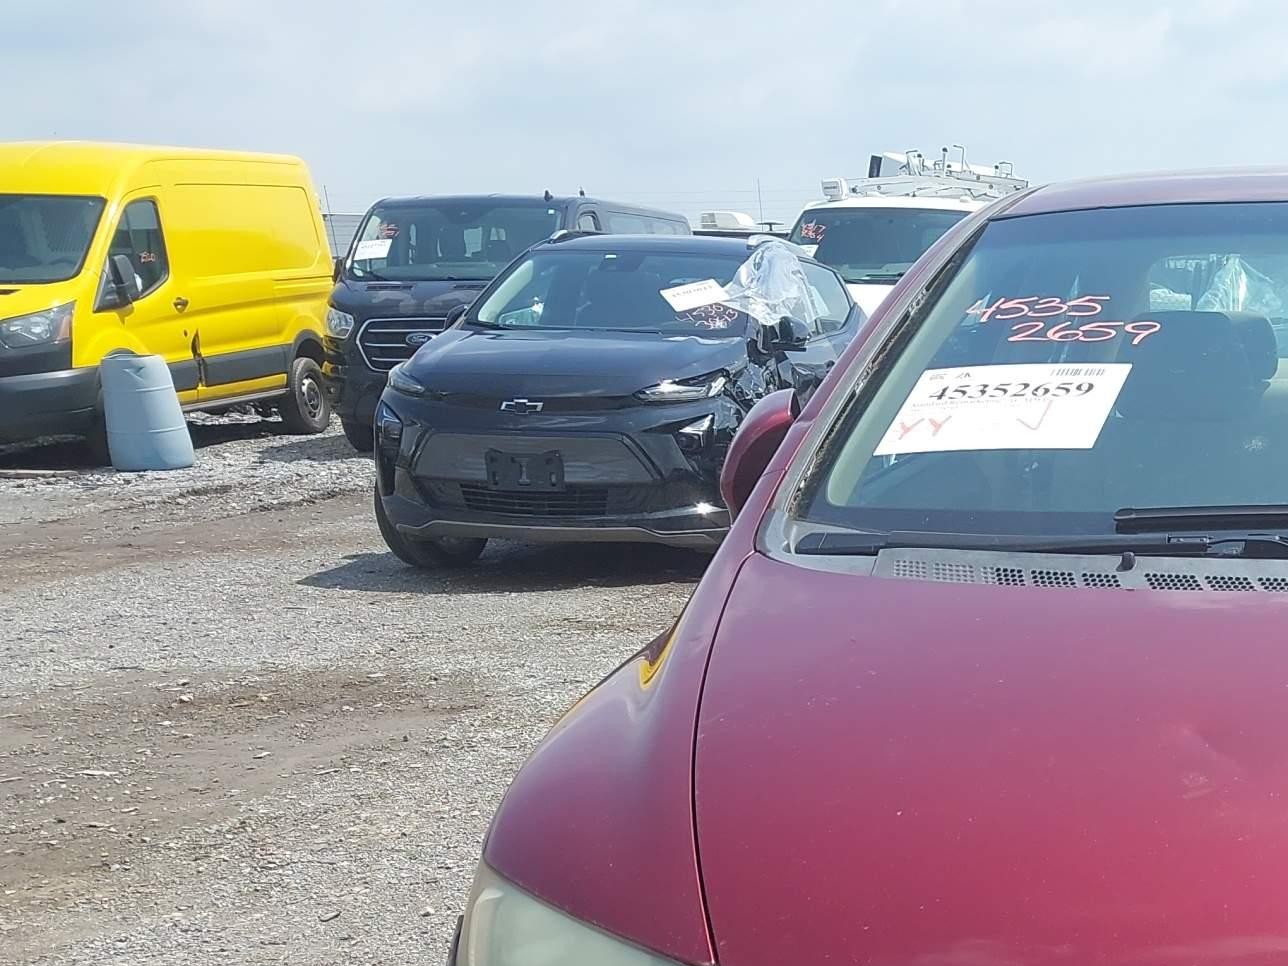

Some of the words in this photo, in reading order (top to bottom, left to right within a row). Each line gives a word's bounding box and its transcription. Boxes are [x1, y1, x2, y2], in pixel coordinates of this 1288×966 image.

[966, 295, 1110, 323] 4535
[1007, 321, 1161, 345] 2659
[929, 382, 1095, 401] 45352659
